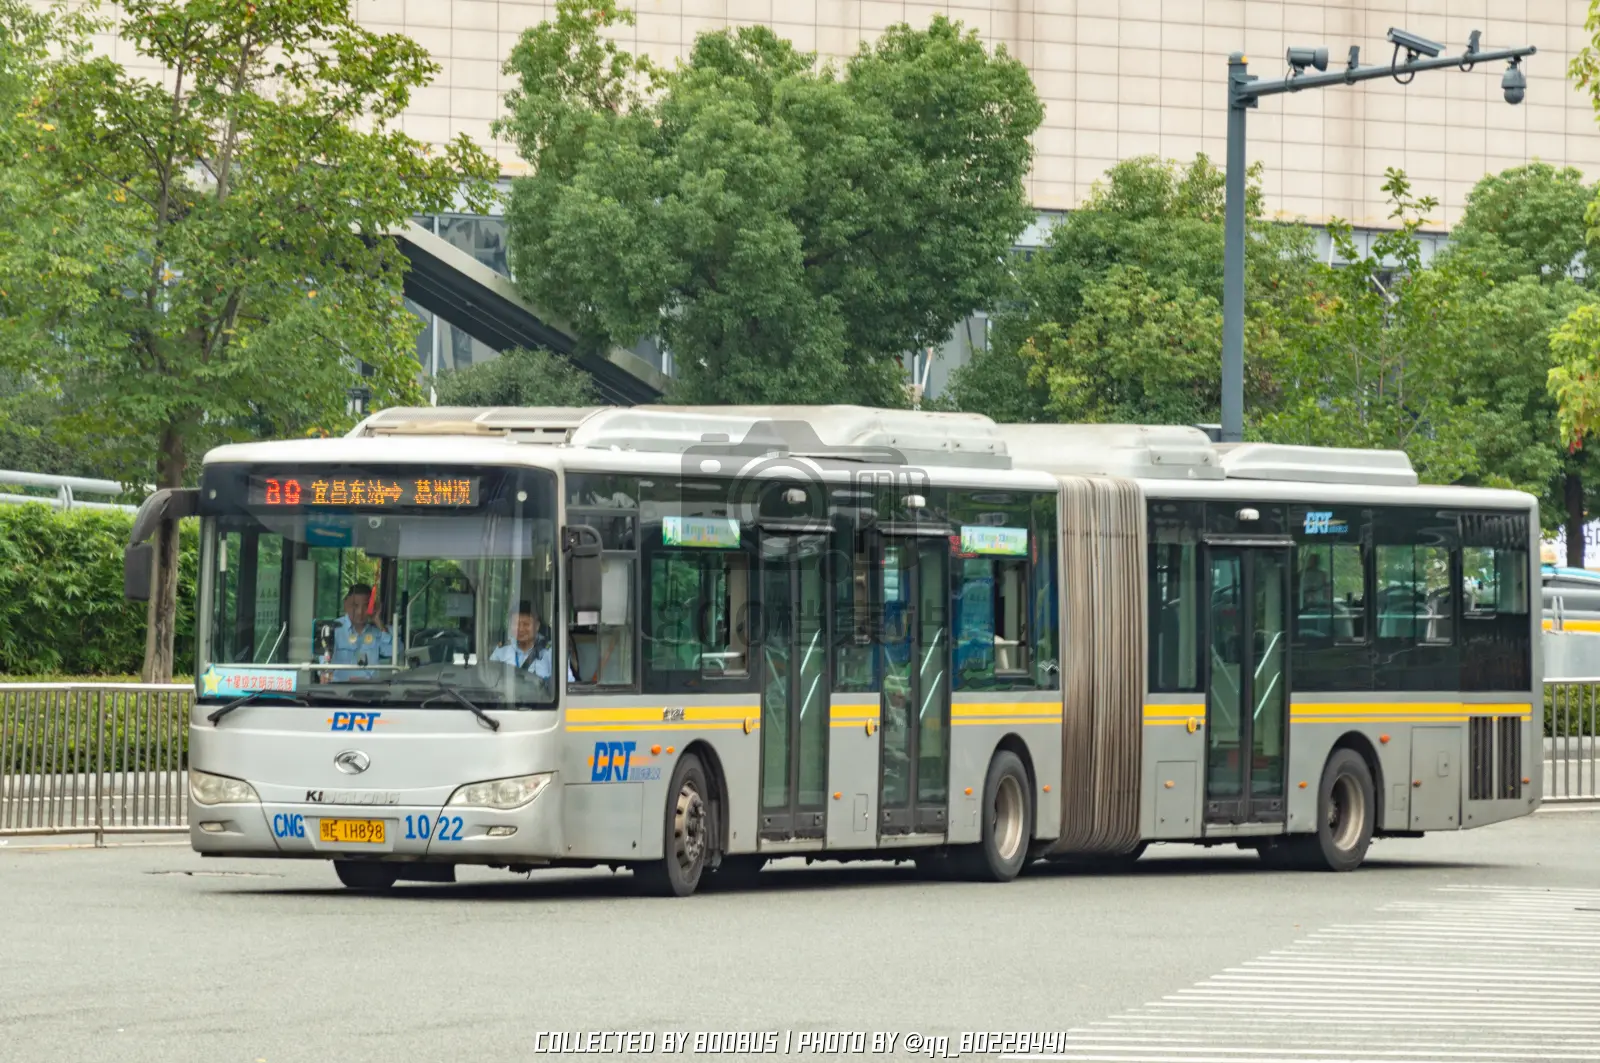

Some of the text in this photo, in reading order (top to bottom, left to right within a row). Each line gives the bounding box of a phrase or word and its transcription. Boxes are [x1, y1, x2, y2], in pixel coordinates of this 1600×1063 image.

[311, 479, 471, 505] 宜昌东站 葛洲坝
[331, 711, 382, 732] BRT
[591, 741, 637, 782] BRT
[273, 813, 305, 838] CNG
